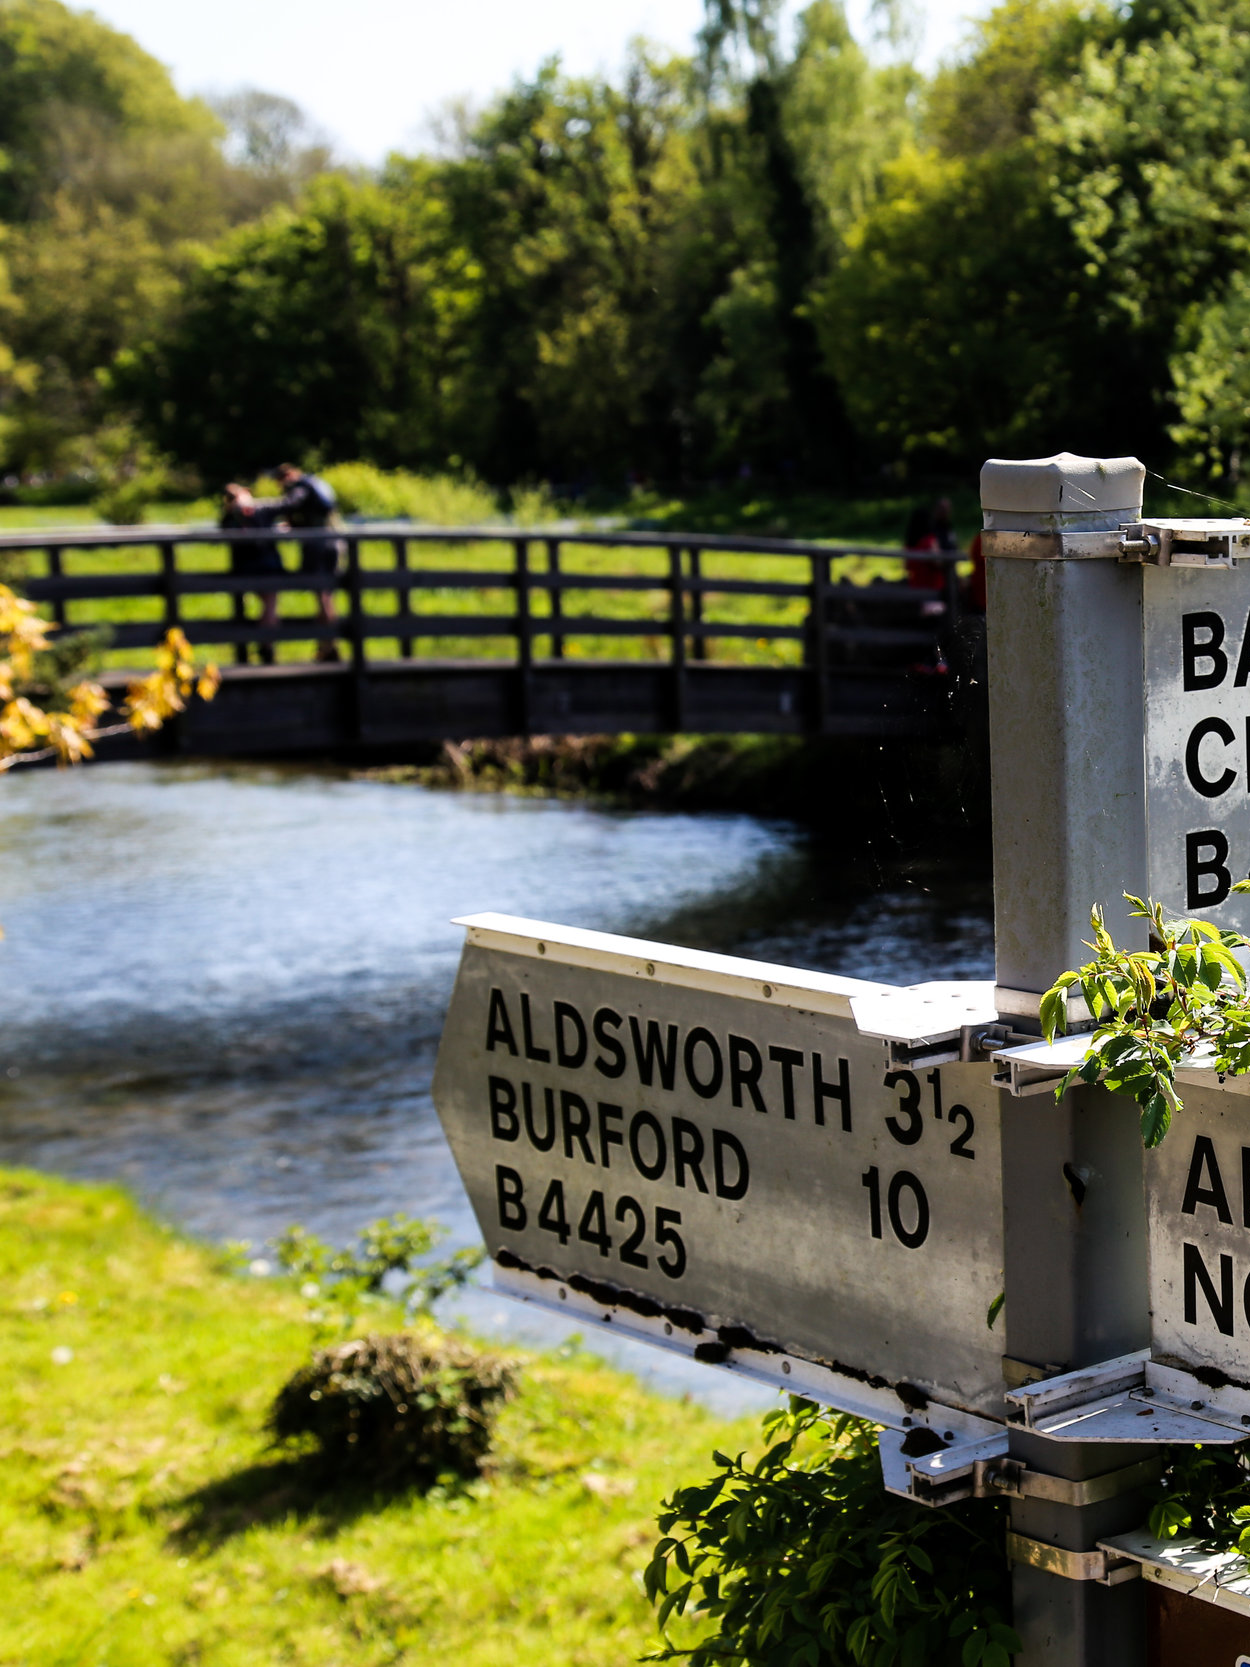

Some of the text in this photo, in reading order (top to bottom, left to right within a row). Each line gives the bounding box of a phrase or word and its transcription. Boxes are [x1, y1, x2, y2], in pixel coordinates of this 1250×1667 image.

[485, 987, 853, 1134] ALDSWORTH
[487, 1074, 930, 1250] BURFORD 10
[494, 1164, 688, 1280] B4425
